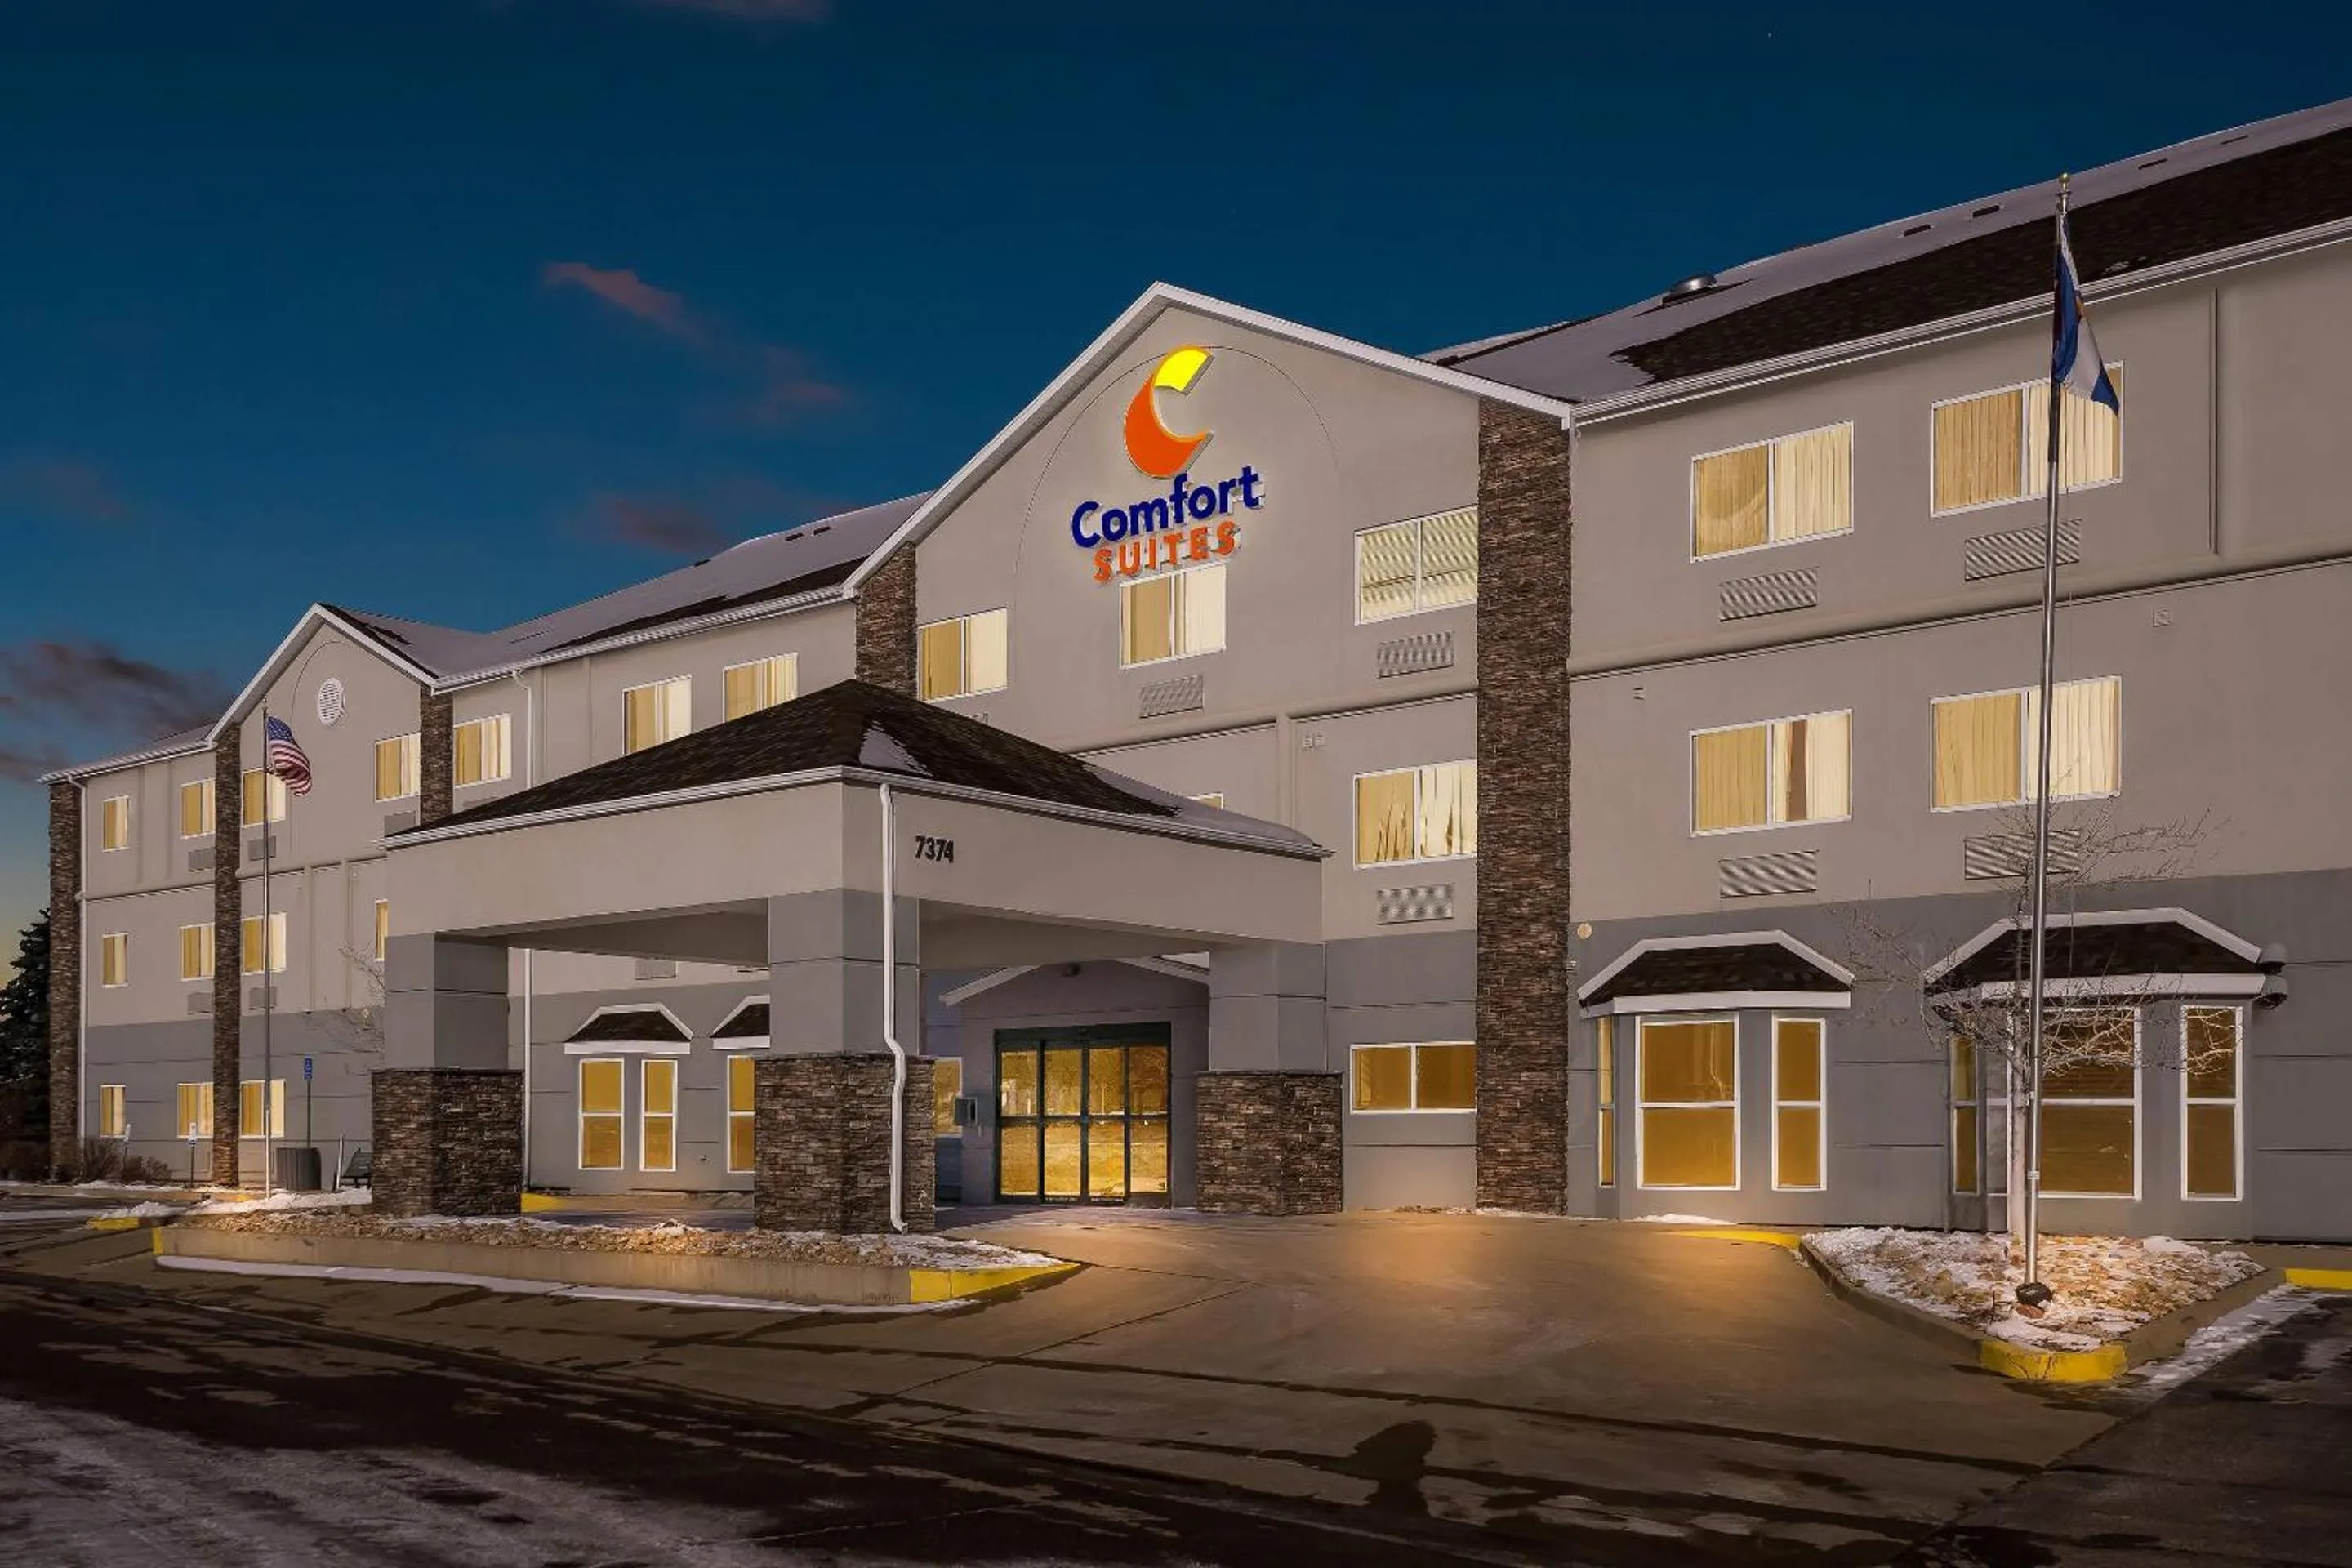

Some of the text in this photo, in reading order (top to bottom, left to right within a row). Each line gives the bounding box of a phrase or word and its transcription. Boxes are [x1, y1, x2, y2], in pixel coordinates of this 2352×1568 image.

[1071, 465, 1260, 548] Comfort
[1093, 519, 1238, 584] SUITES
[915, 835, 955, 863] 7374
